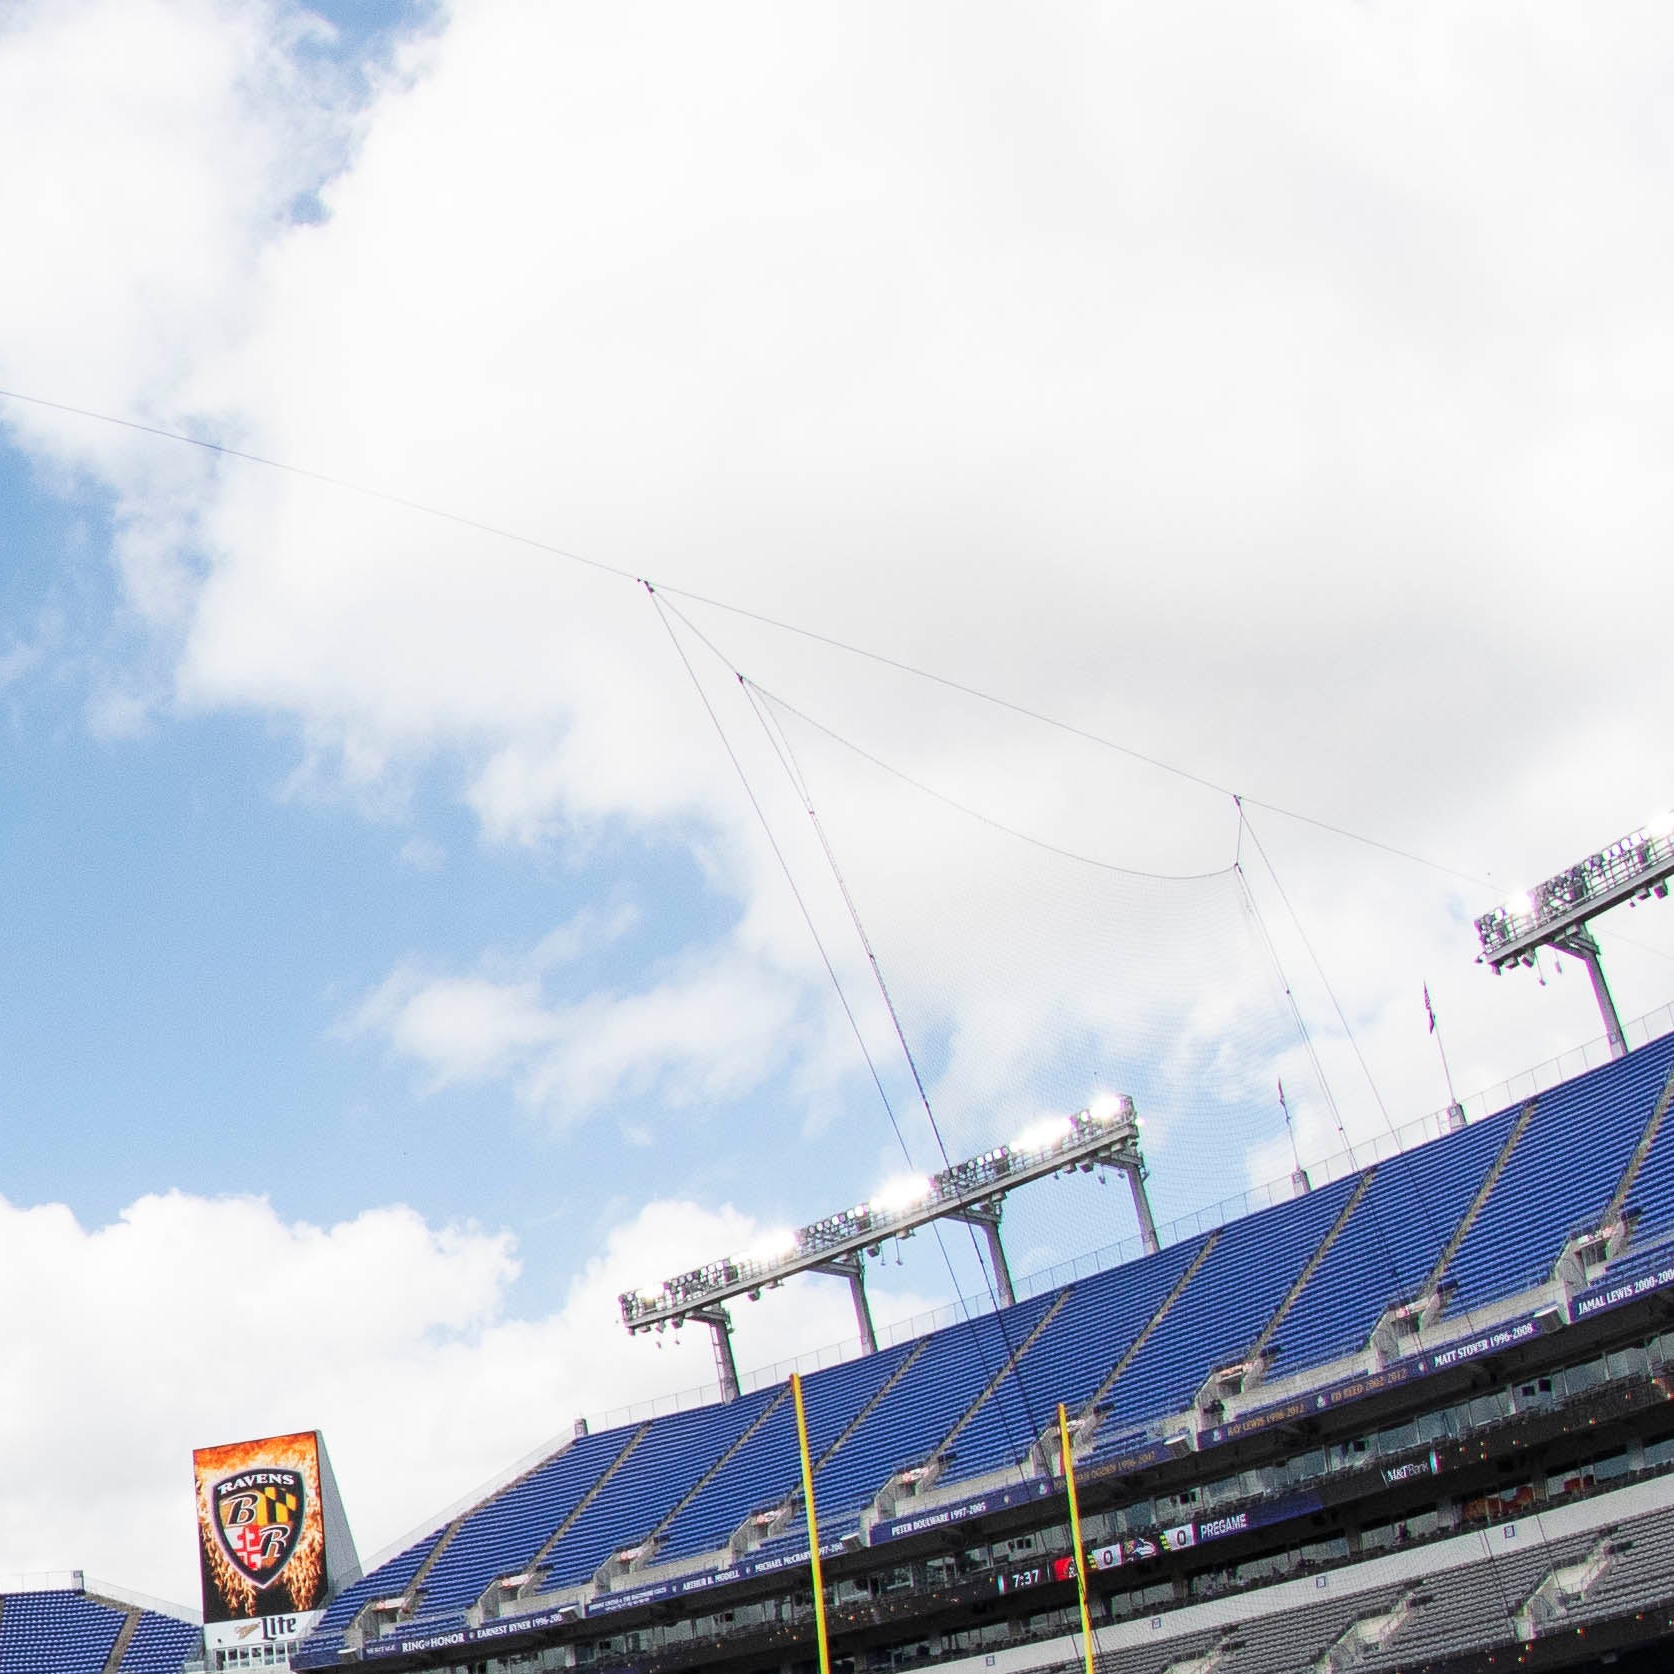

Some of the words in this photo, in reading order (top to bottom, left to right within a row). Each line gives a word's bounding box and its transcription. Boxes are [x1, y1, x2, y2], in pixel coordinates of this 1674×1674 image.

[1577, 1297, 1606, 1316] JAMAL
[1606, 1285, 1633, 1306] LEWIS
[1434, 1350, 1457, 1368] MATT
[217, 1474, 295, 1496] RAVENS
[221, 1492, 261, 1527] B
[1177, 1529, 1187, 1547] 0
[1199, 1514, 1248, 1540] PREGAME
[1102, 1549, 1113, 1566] 0
[1012, 1568, 1040, 1589] 7:37
[261, 1616, 296, 1640] Lite
[402, 1639, 425, 1653] RING
[430, 1632, 465, 1649] HONOR
